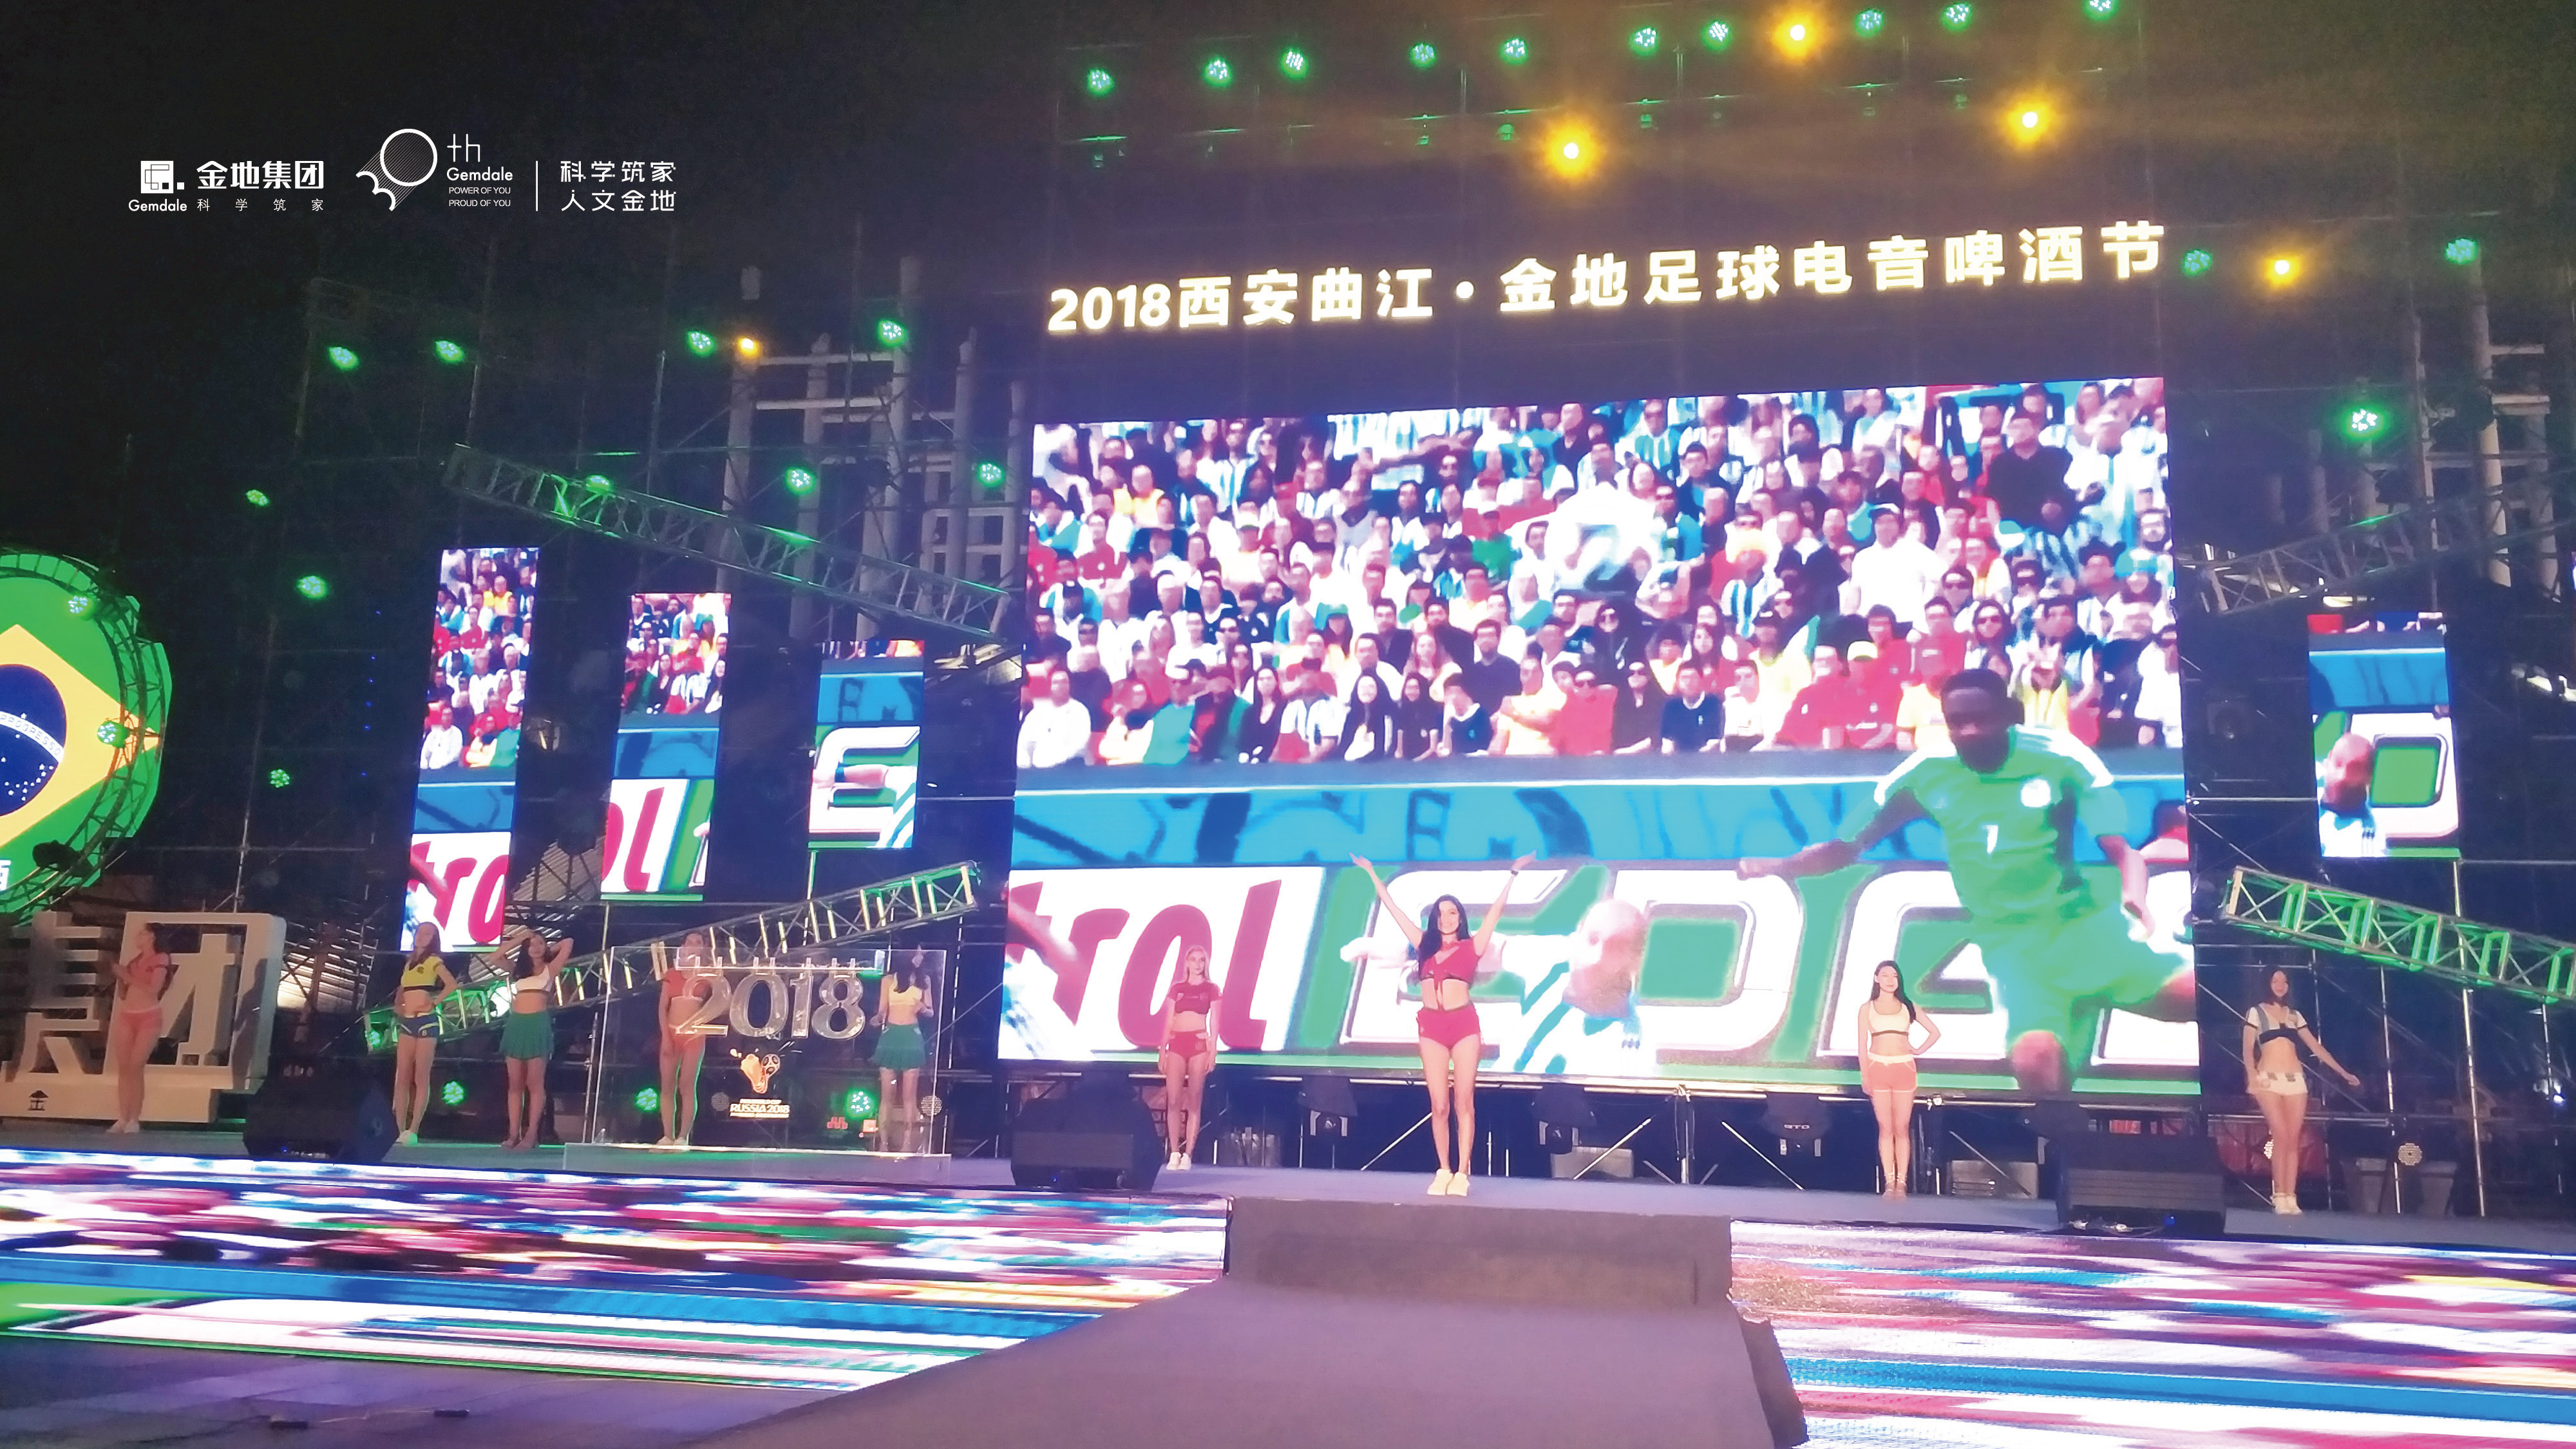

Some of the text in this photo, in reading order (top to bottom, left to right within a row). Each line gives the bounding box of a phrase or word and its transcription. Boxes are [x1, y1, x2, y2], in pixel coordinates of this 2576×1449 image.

[675, 971, 866, 1040] 2018
[730, 1103, 790, 1113] RUSSIA 2018
